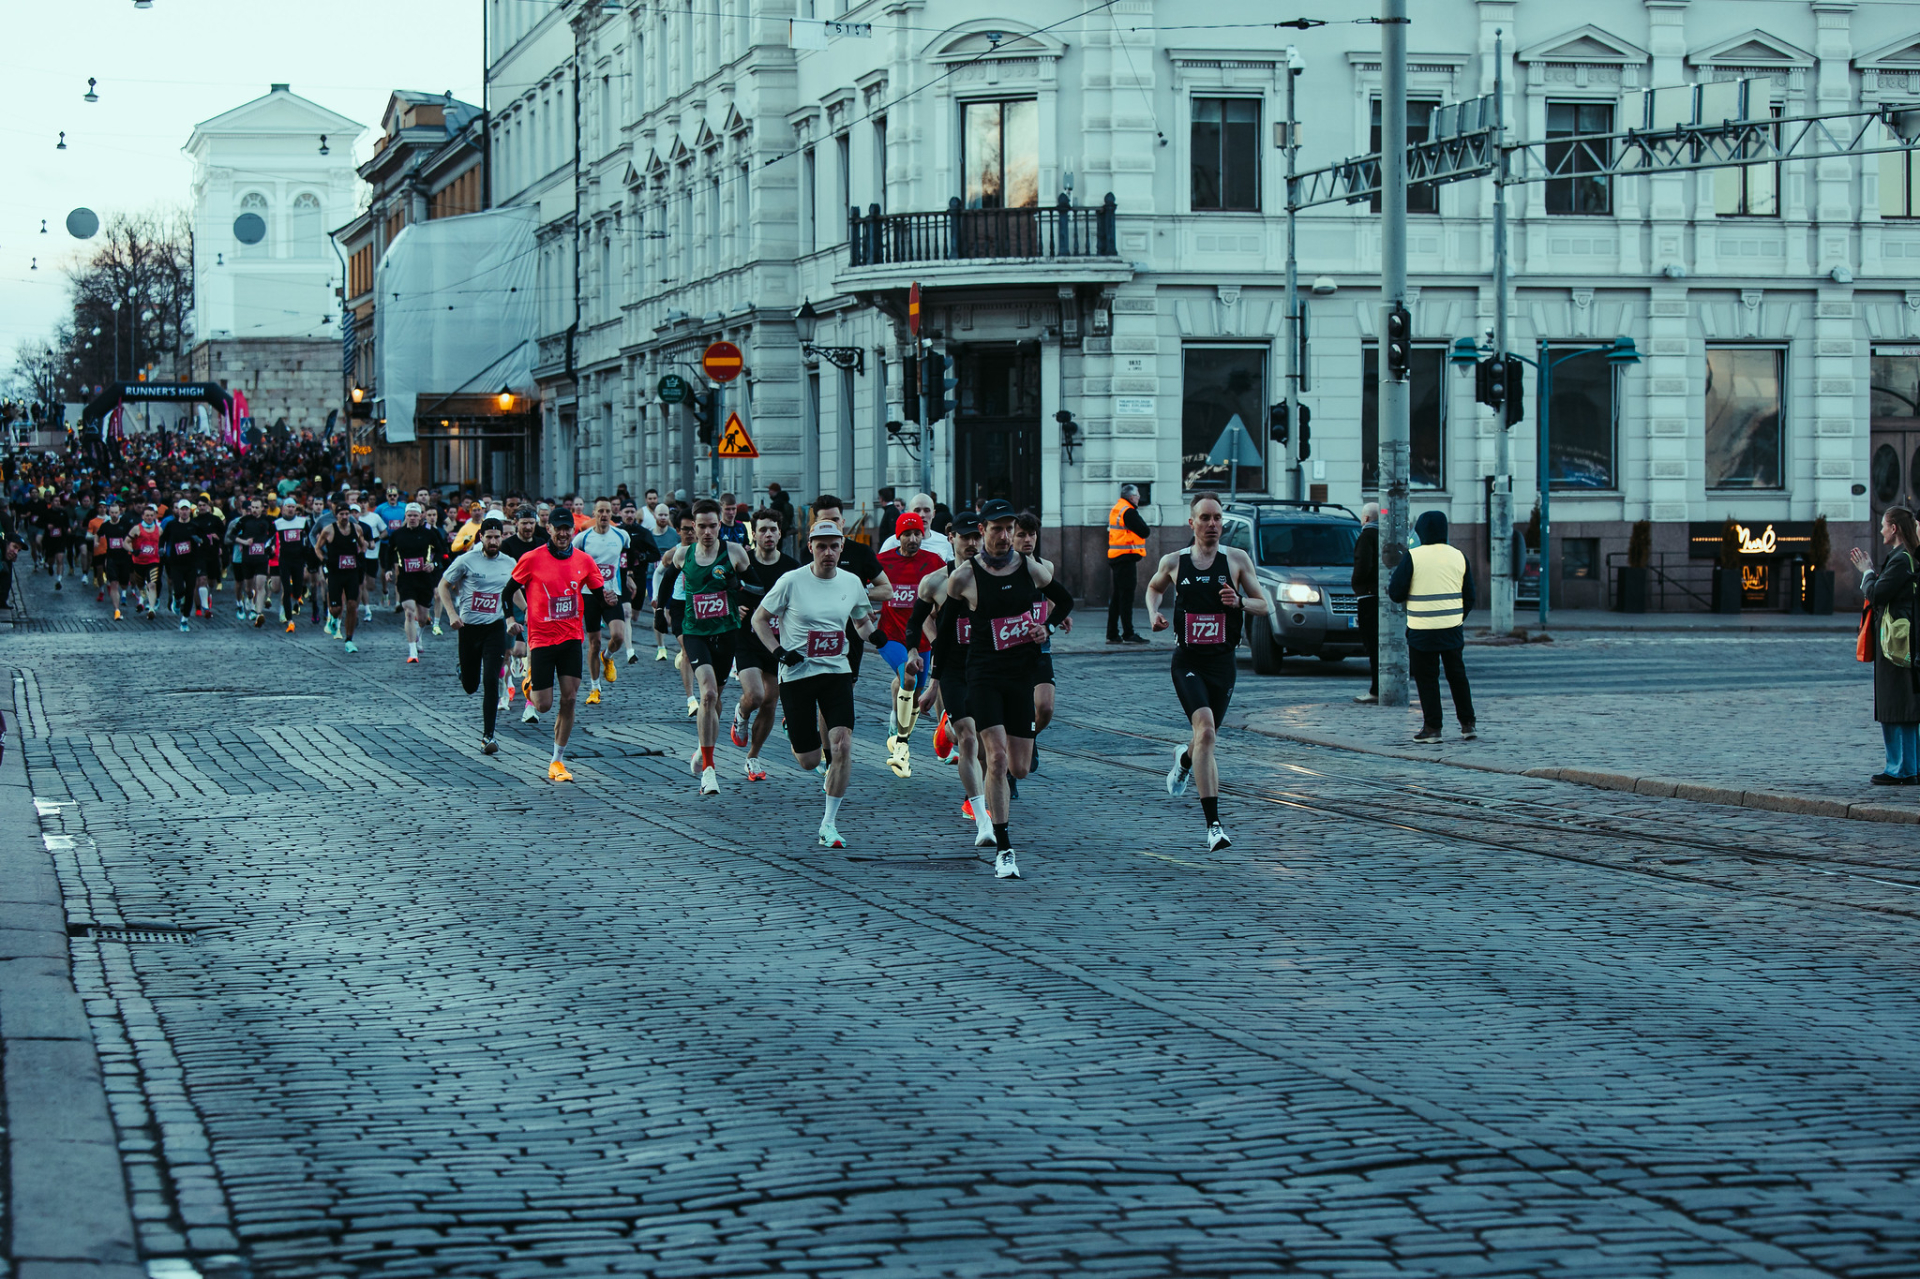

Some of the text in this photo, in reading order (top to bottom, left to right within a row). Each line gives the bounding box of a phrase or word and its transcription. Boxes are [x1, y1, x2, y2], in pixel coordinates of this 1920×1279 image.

[125, 386, 205, 396] RUNNER'S HIGH
[893, 590, 915, 602] 405
[474, 597, 497, 609] 1702
[555, 601, 572, 613] 1181
[697, 598, 724, 614] 1729
[999, 620, 1030, 641] 645
[1192, 622, 1219, 638] 1721
[814, 638, 839, 651] 143
